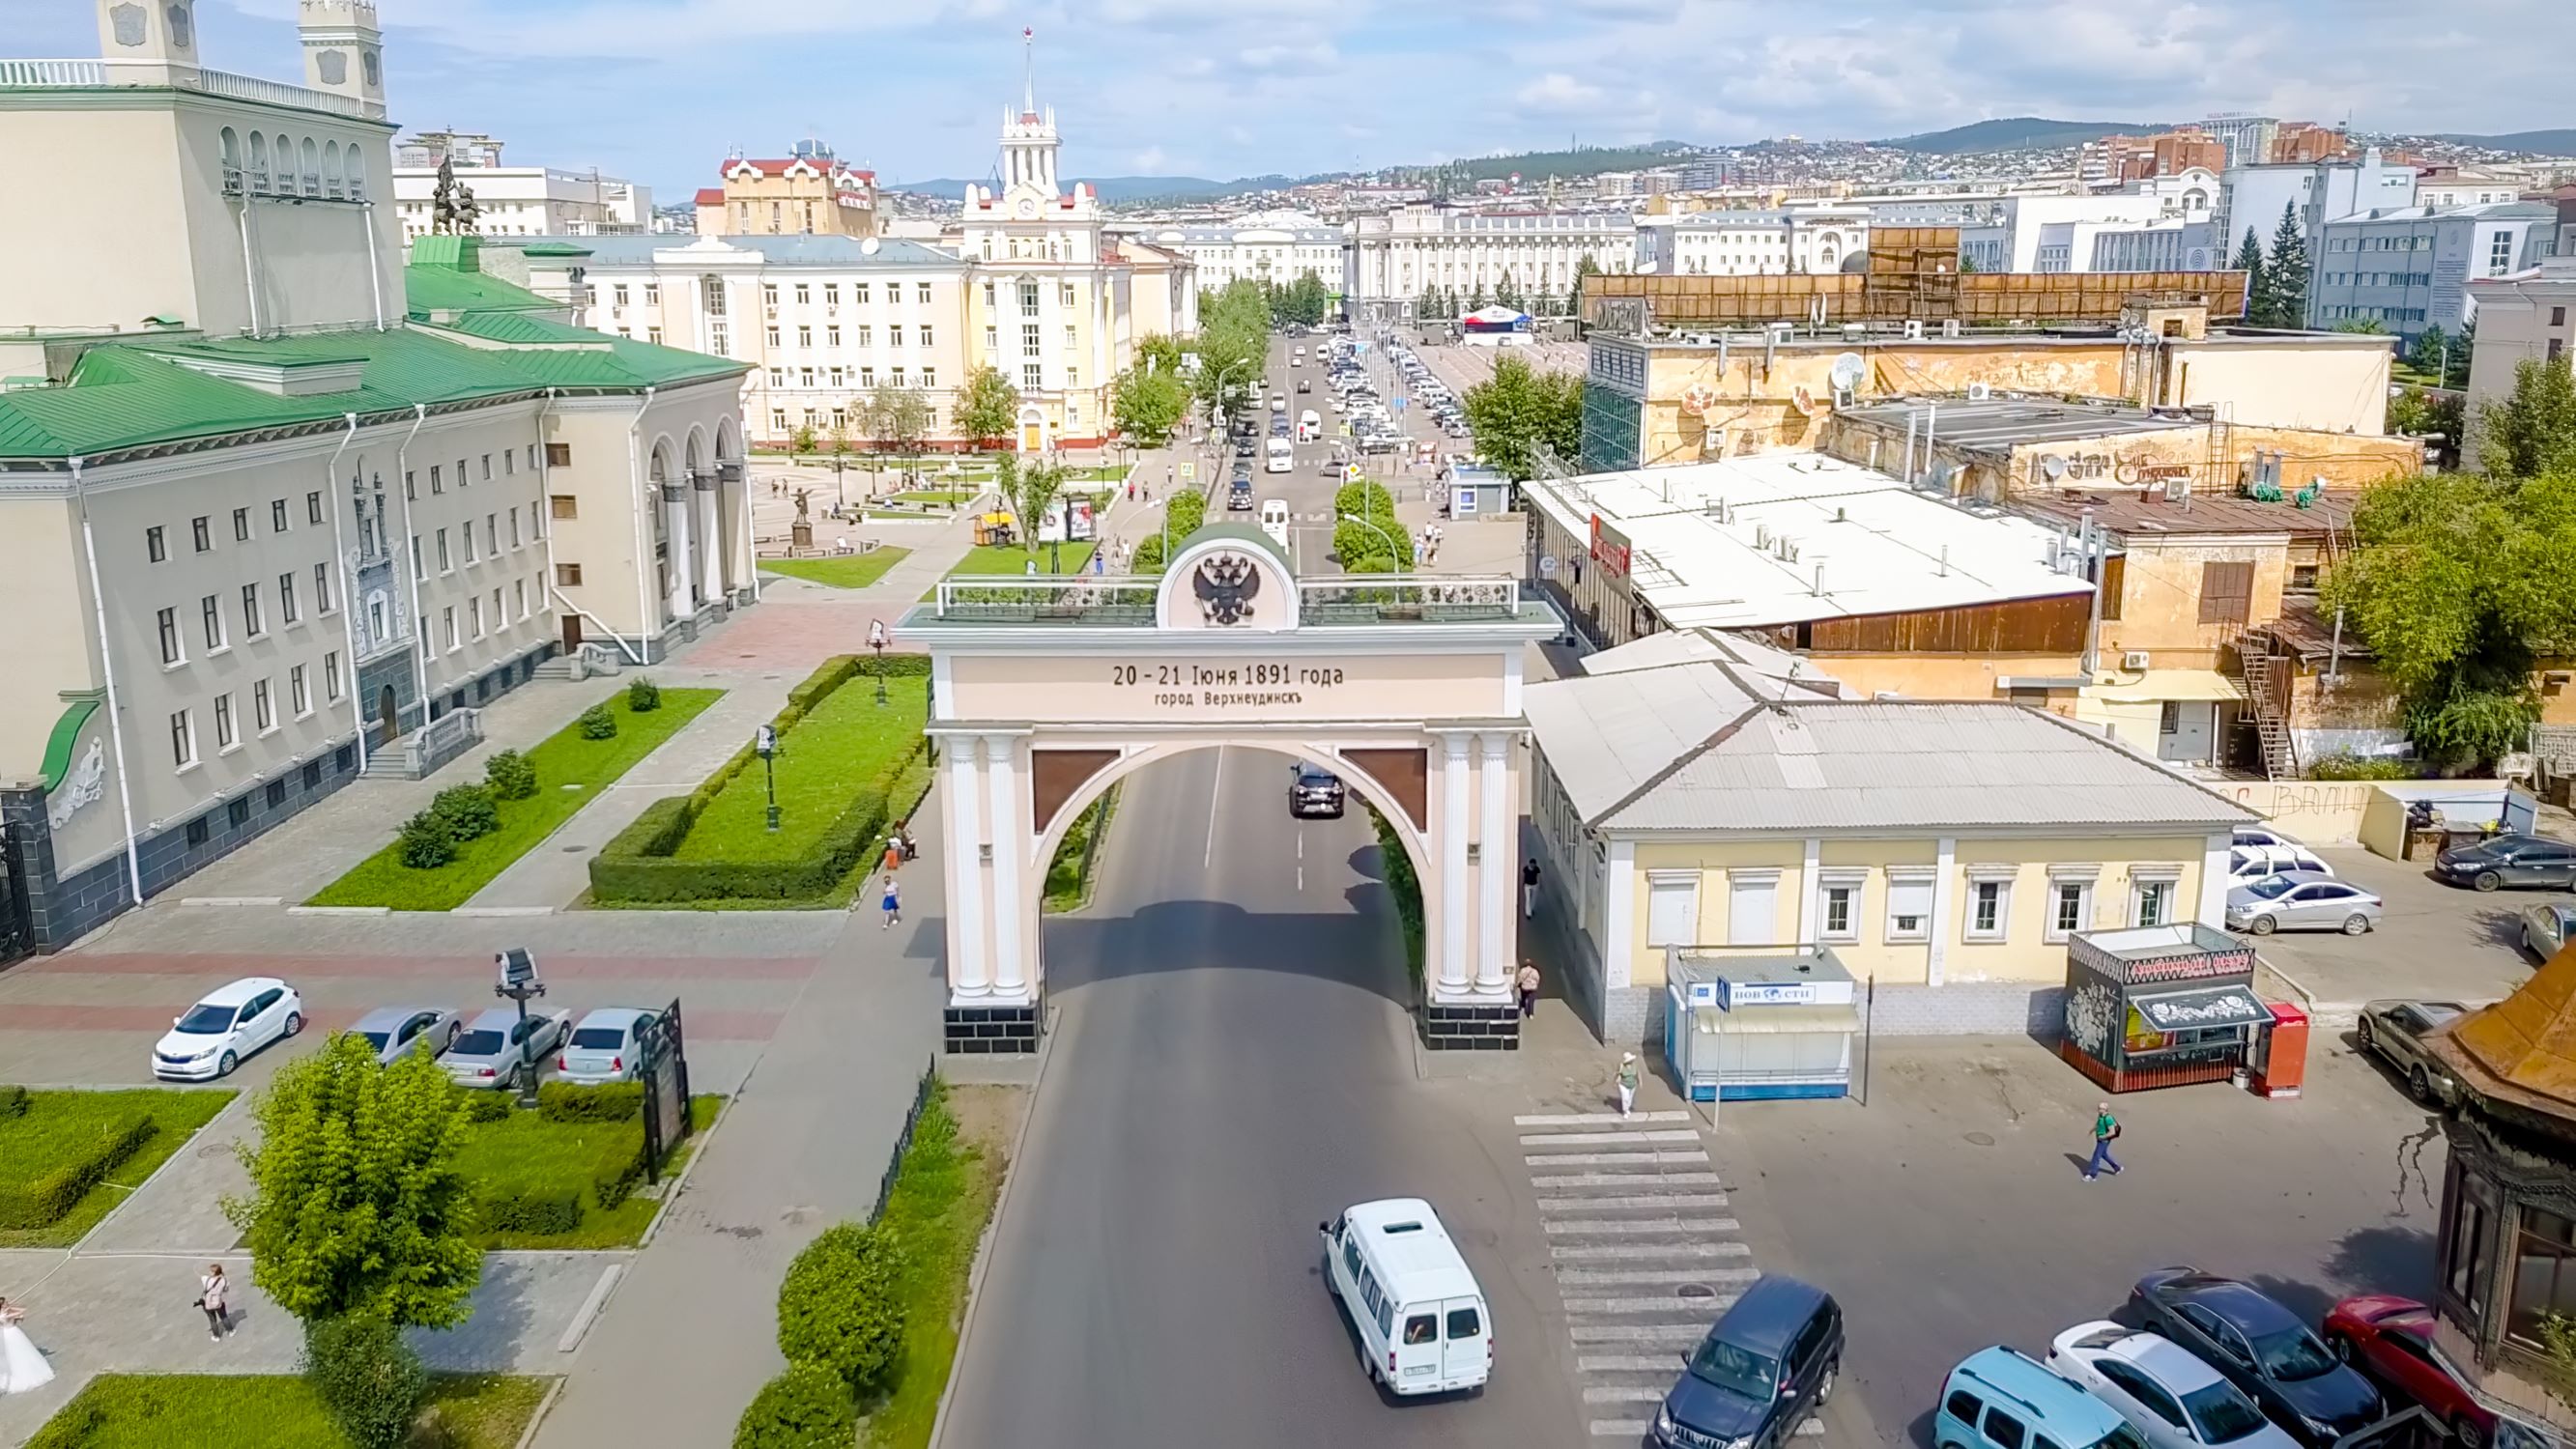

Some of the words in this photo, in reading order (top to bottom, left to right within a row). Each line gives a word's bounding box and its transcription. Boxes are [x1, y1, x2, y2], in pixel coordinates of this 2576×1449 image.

[1113, 666, 1137, 686] 20
[1159, 666, 1181, 686] 21
[1245, 664, 1291, 685] 1891
[1300, 668, 1344, 688] года
[1155, 692, 1194, 707] город
[1204, 692, 1302, 707] Верхнеудинскъ
